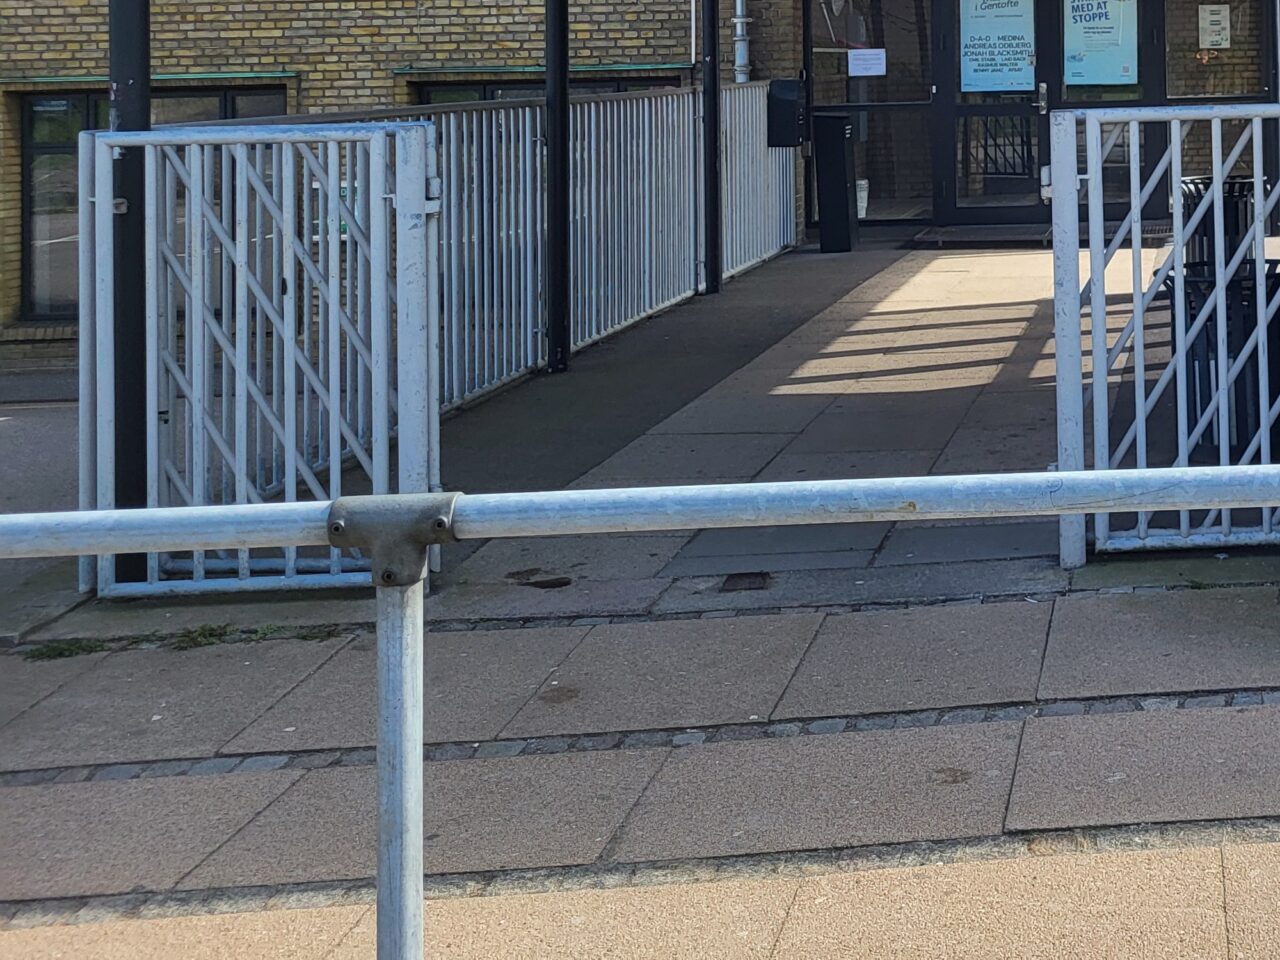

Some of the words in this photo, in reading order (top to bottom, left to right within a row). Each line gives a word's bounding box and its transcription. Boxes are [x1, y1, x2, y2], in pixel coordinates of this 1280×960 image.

[980, 0, 1019, 11] Gentofte
[1071, 2, 1094, 13] MED
[1097, 1, 1108, 11] AT
[1072, 11, 1110, 24] STOPPE
